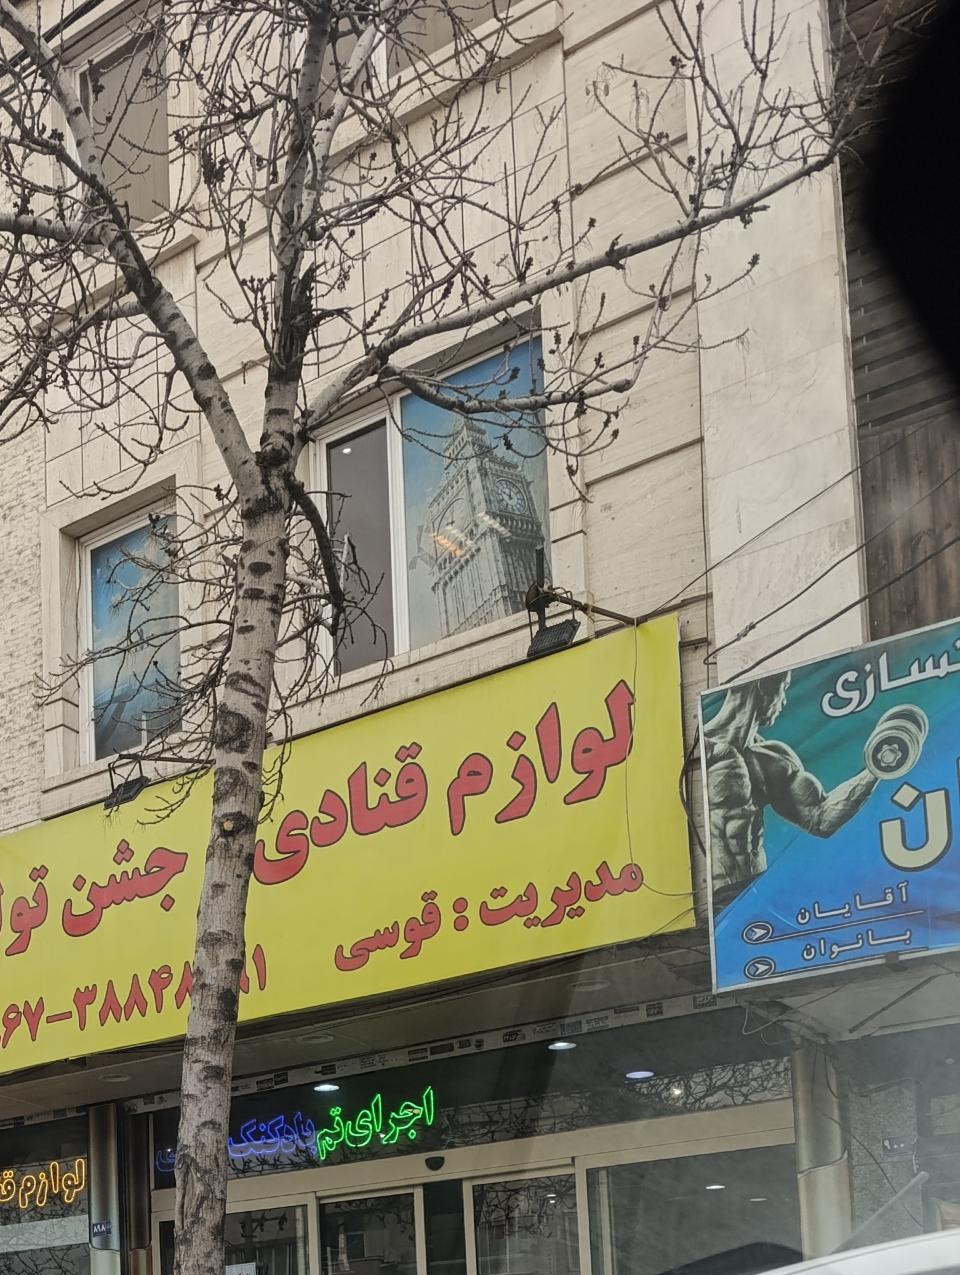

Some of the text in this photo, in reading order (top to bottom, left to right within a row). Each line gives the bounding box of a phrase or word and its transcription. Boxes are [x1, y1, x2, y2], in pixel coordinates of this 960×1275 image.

[448, 679, 635, 836] لوازم
[252, 741, 429, 886] قنادی
[61, 838, 189, 938] جشن
[796, 882, 910, 924] آقایان
[334, 890, 442, 971] قوسی
[801, 929, 913, 961] بانوان
[316, 1106, 344, 1160] تم
[344, 1085, 434, 1147] اجرای
[18, 1158, 85, 1209] لوازم
